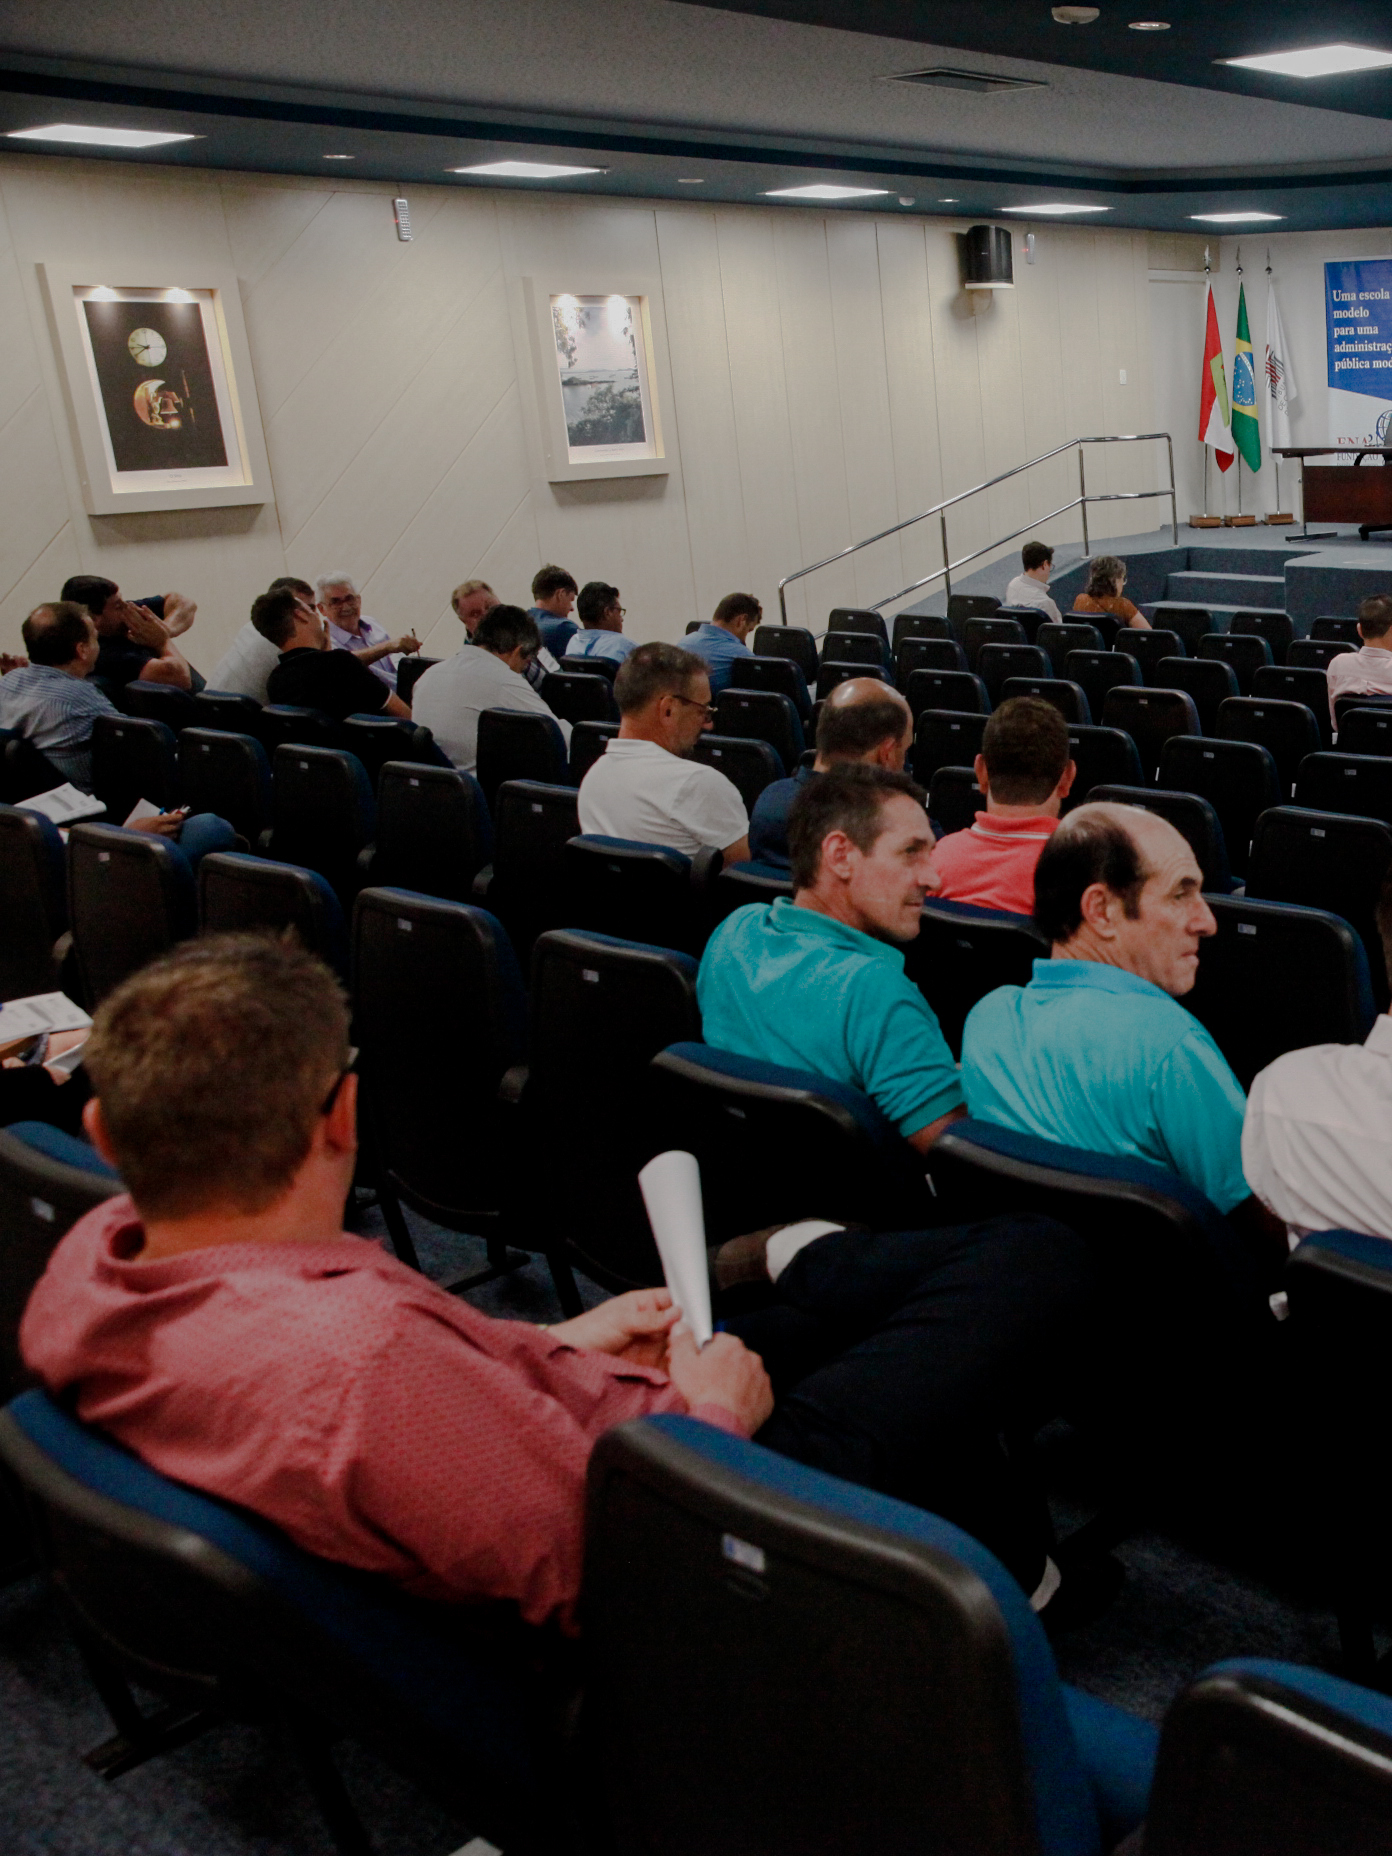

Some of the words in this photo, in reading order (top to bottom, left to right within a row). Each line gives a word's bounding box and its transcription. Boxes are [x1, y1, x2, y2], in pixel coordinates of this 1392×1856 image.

[1333, 290, 1356, 301] Uma
[1359, 288, 1390, 300] escola
[1334, 306, 1369, 318] modelo
[1334, 327, 1355, 338] para
[1357, 326, 1378, 334] uma
[1335, 357, 1370, 372] pública
